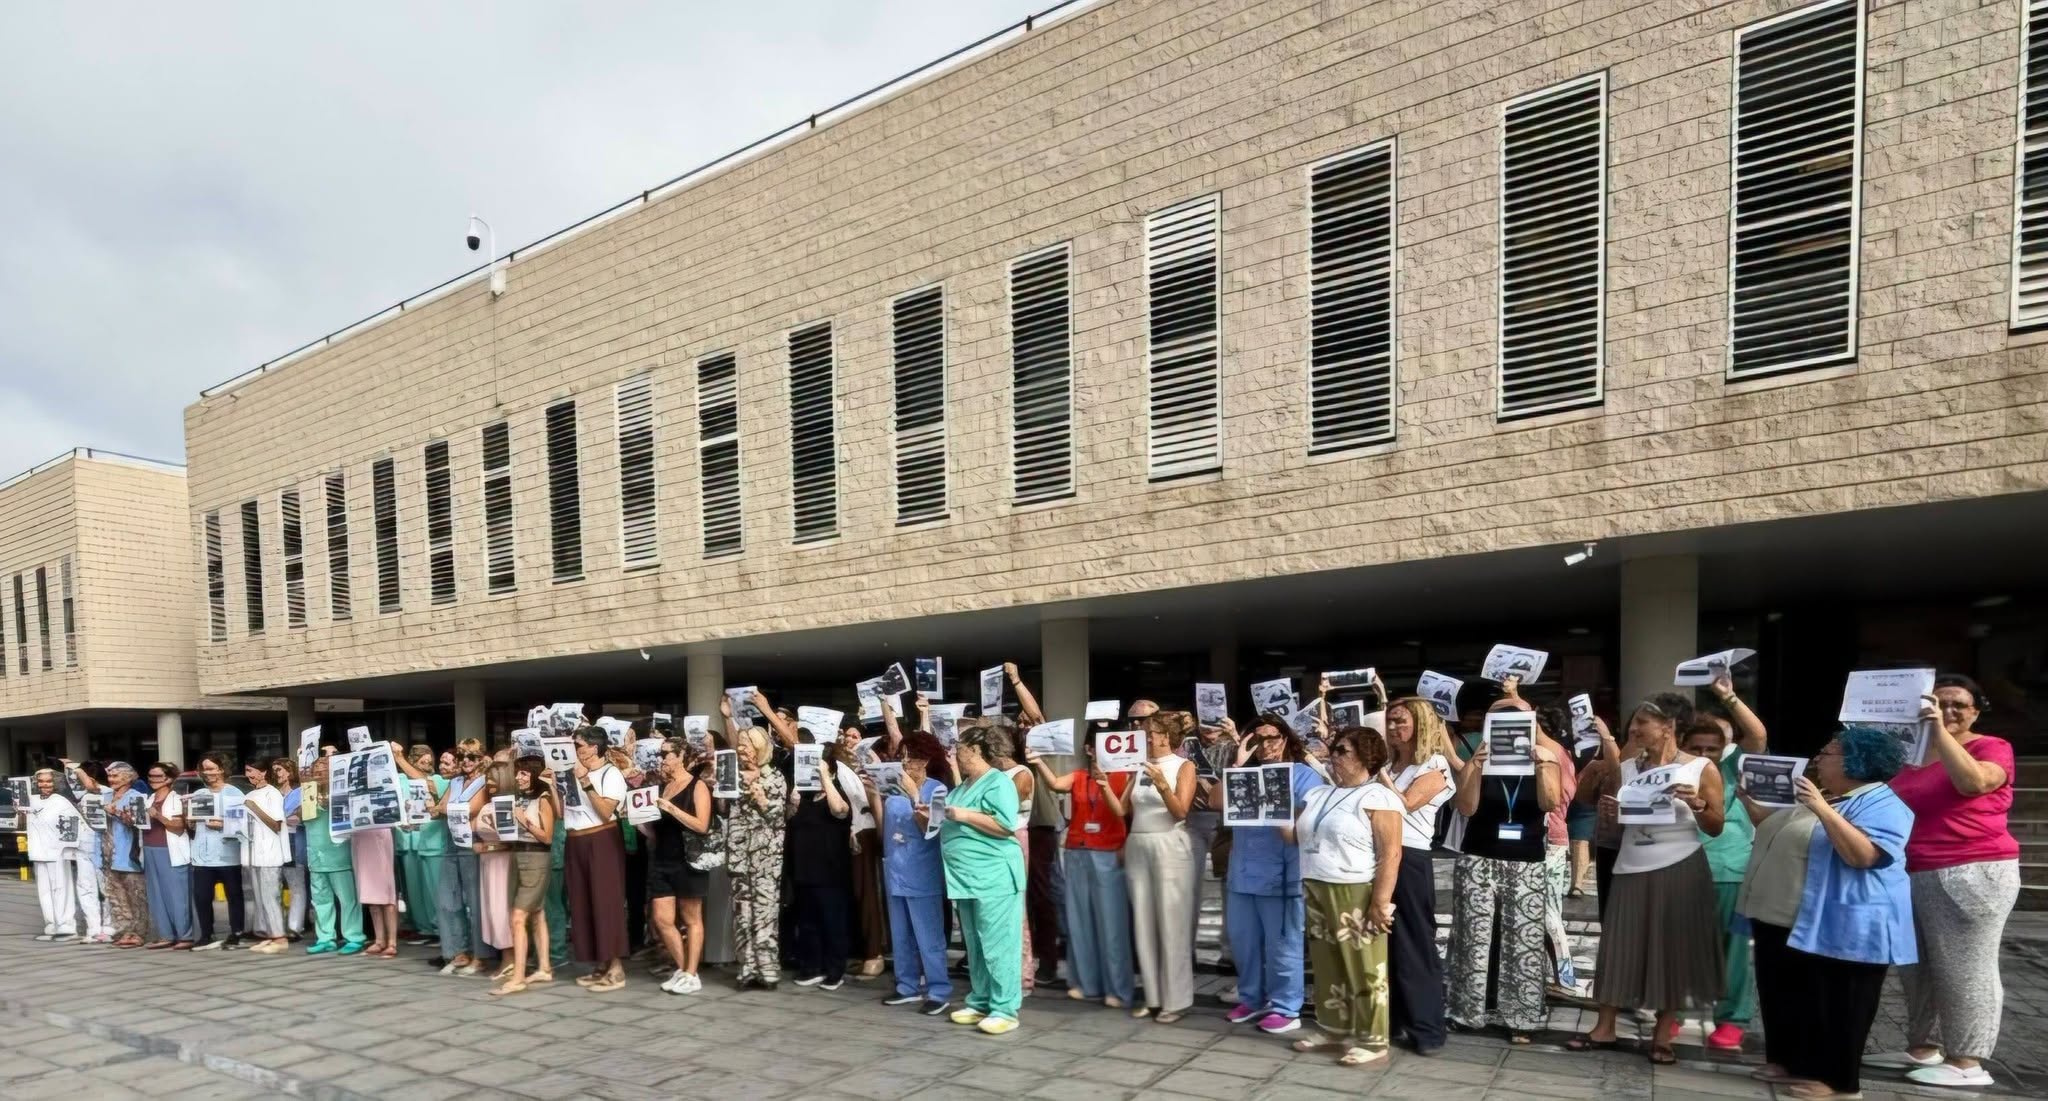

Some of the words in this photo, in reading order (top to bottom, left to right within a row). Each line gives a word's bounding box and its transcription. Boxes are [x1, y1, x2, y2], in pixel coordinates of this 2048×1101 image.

[1104, 734, 1139, 754] C1
[550, 748, 568, 761] C1
[632, 790, 654, 808] C1
